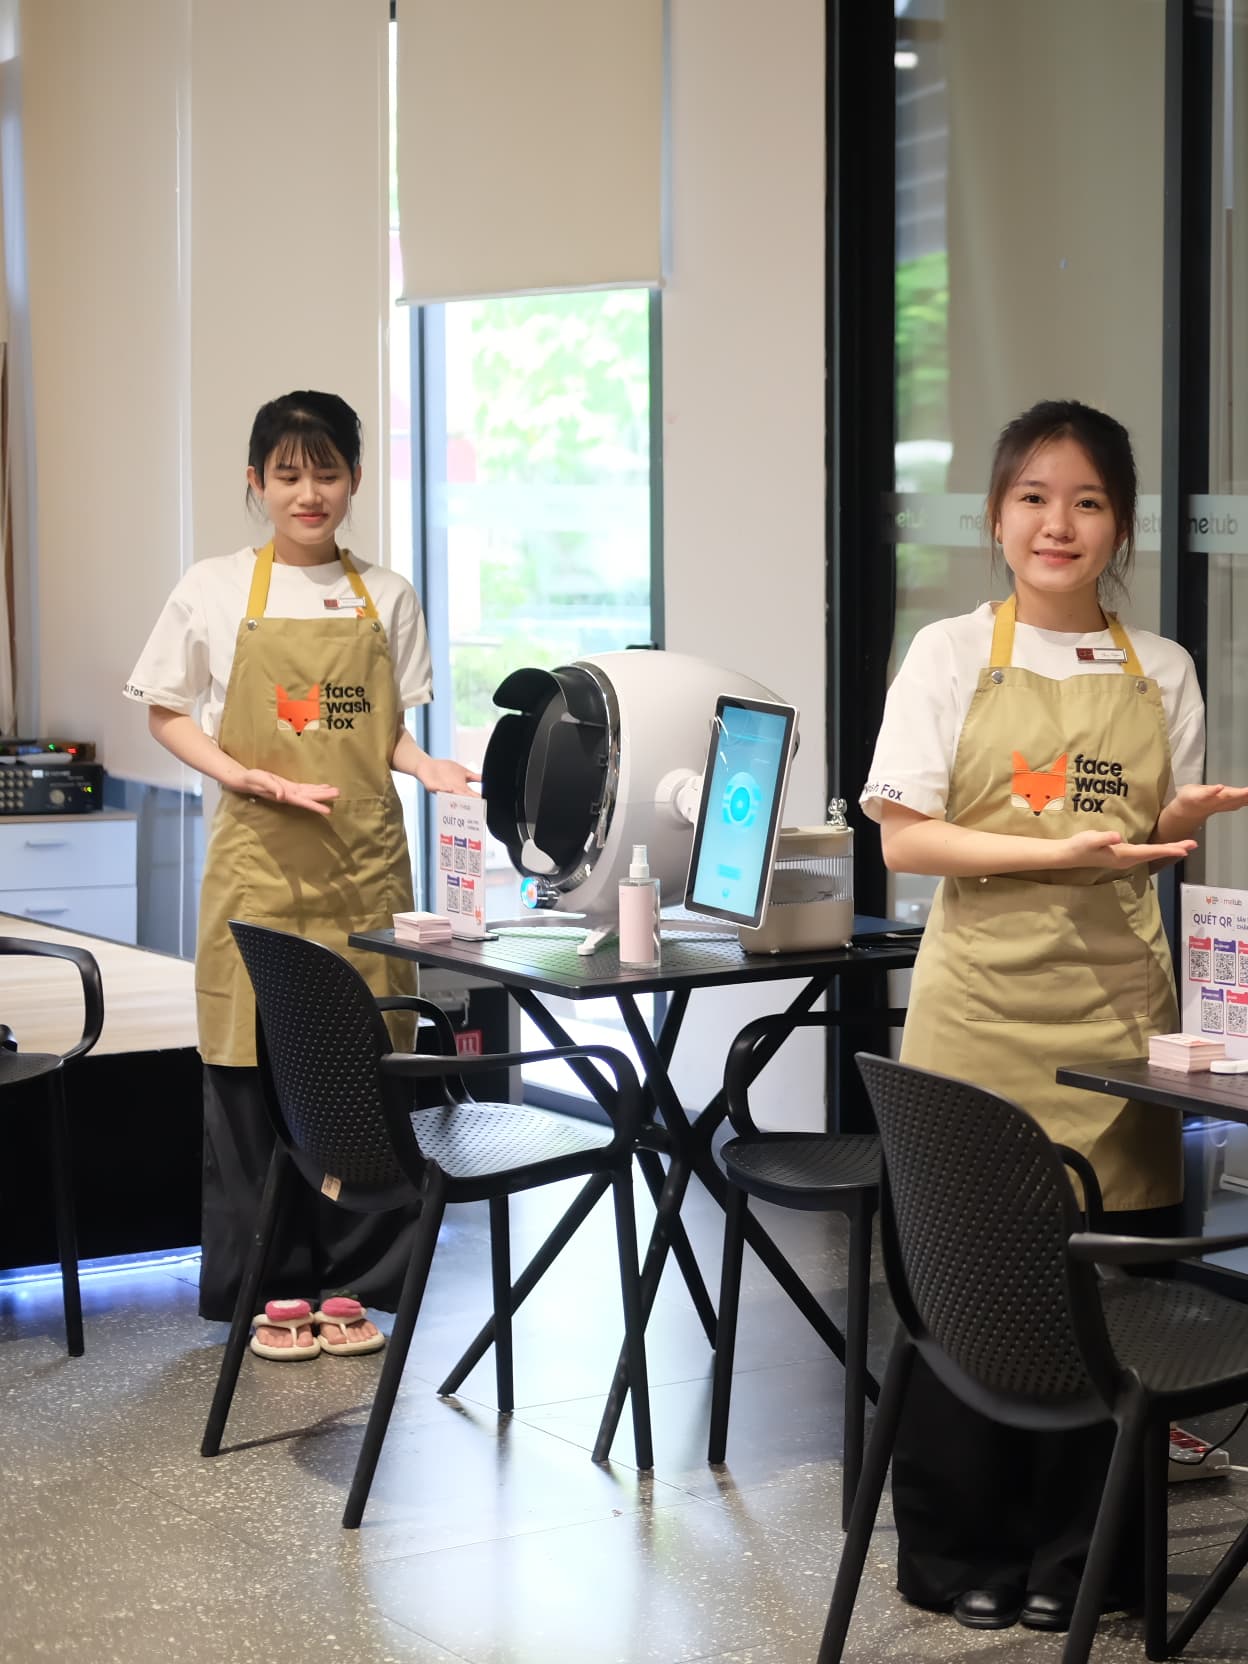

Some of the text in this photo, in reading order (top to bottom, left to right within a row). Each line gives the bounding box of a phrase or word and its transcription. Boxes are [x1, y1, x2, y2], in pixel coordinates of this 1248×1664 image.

[324, 682, 366, 700] face
[325, 698, 371, 714] wash
[326, 714, 355, 731] fox
[1073, 753, 1123, 777] face
[880, 783, 903, 801] Fox
[1074, 777, 1129, 798] wash
[1071, 793, 1105, 814] fox
[1219, 916, 1233, 928] QR
